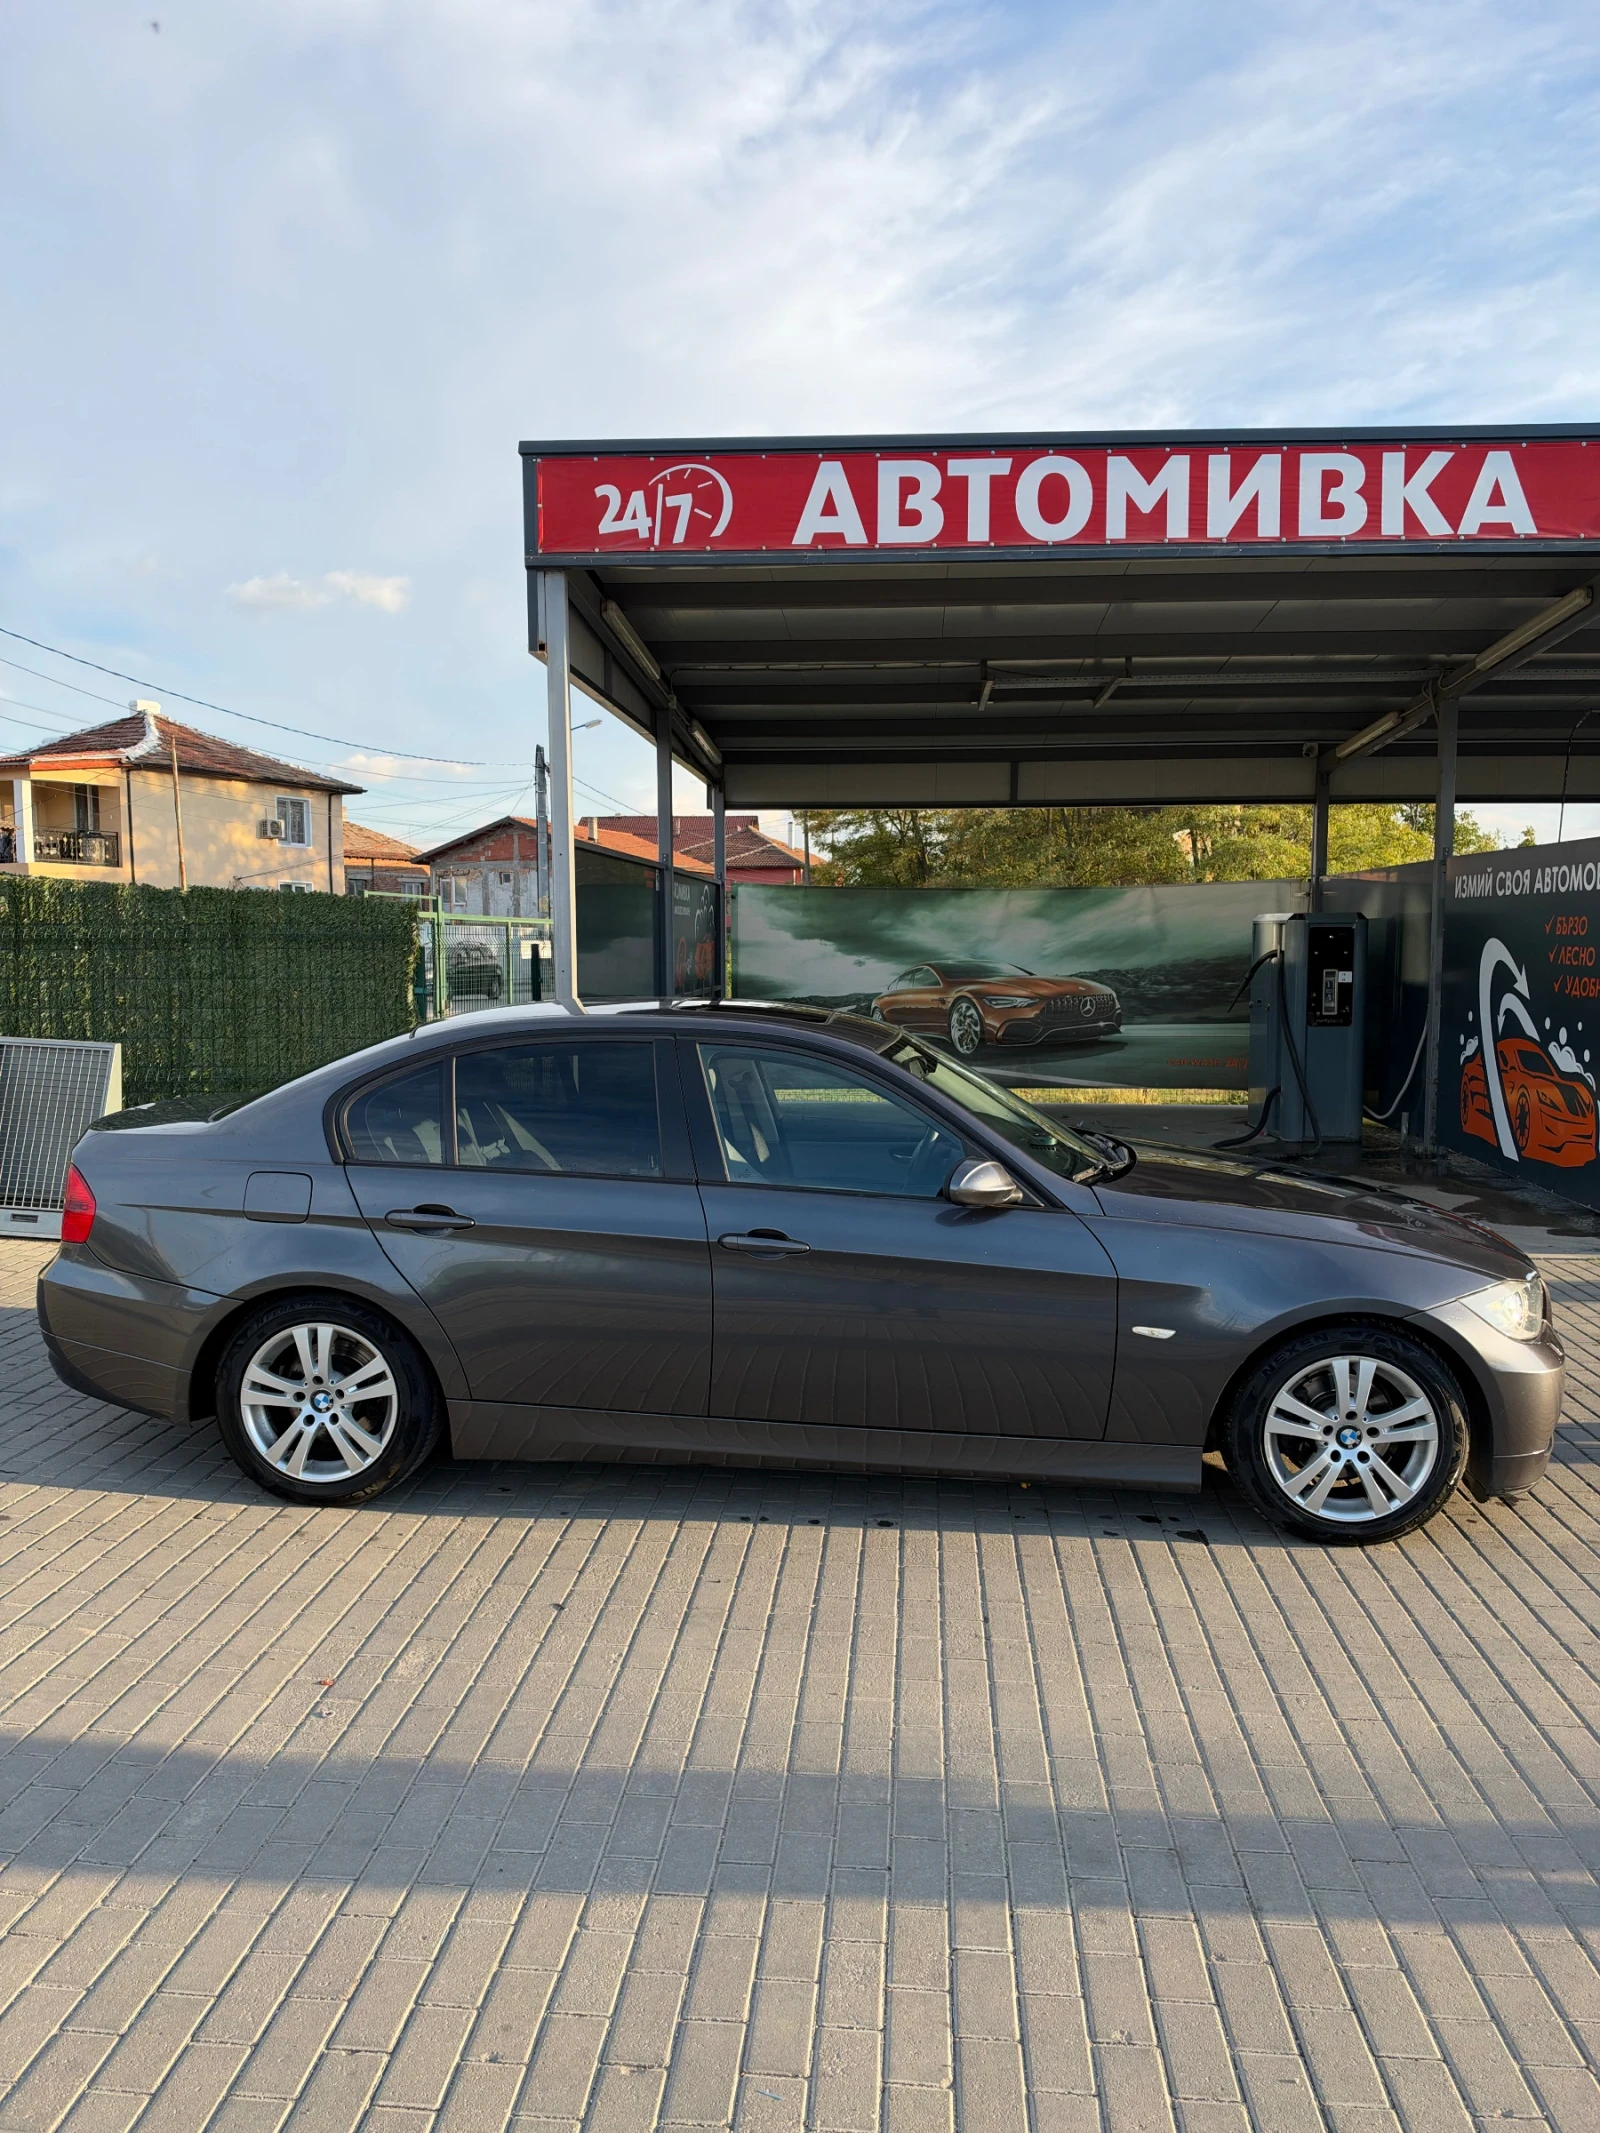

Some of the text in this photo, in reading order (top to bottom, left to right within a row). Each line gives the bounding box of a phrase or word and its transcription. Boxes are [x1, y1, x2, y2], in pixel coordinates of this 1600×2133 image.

[594, 482, 693, 546] 24/7
[791, 450, 1538, 546] АВТОМИВКА
[1454, 866, 1493, 898] ИЗМИЙ
[1495, 868, 1531, 896] СВОЯ
[1555, 915, 1588, 936] БЪРЗО
[1557, 946, 1596, 967] ЛЕСНО
[1166, 1055, 1249, 1070] CAR WASH 24/7
[1261, 1332, 1329, 1378] NEXEN
